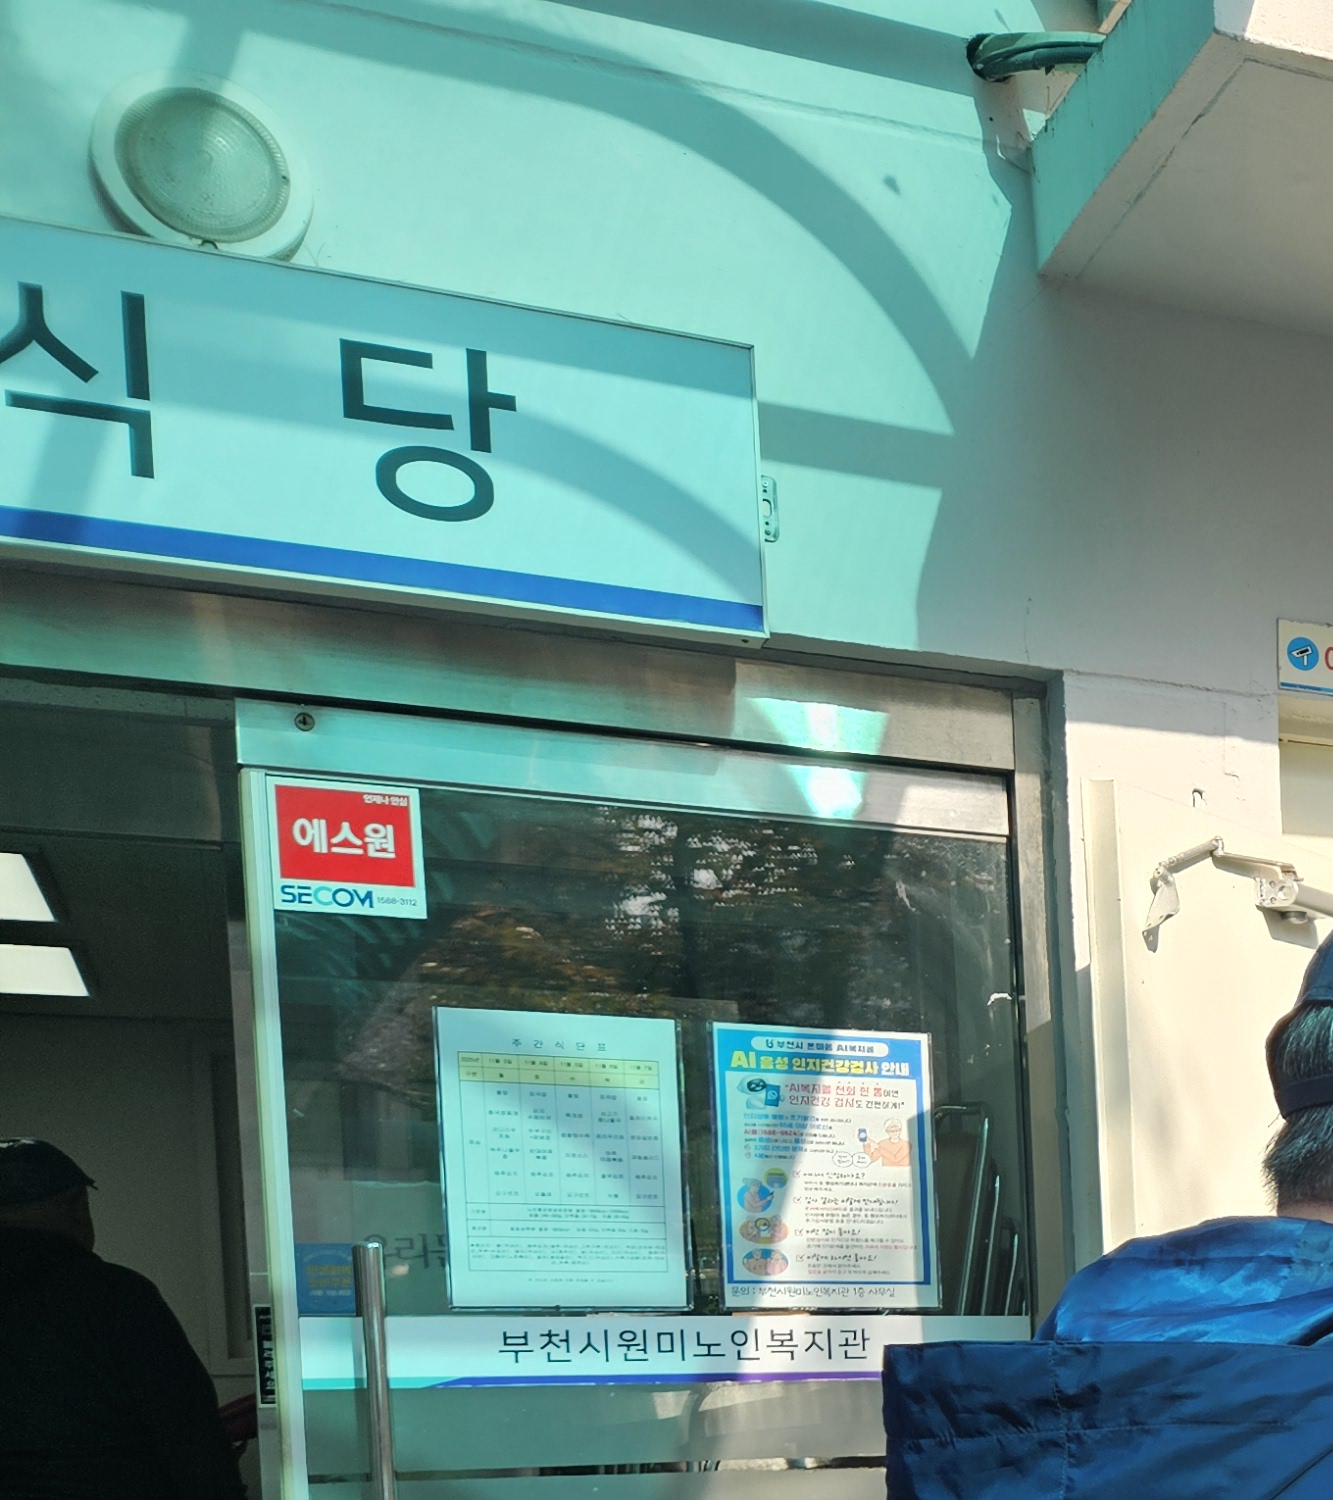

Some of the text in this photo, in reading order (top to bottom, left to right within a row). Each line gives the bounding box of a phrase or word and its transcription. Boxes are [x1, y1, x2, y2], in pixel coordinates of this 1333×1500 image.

[292, 817, 396, 859] 에스원
[280, 885, 374, 909] SECOM
[730, 1051, 756, 1068] AI
[881, 1061, 910, 1076] 안내
[498, 1323, 871, 1365] 부천시원미노인복지관
